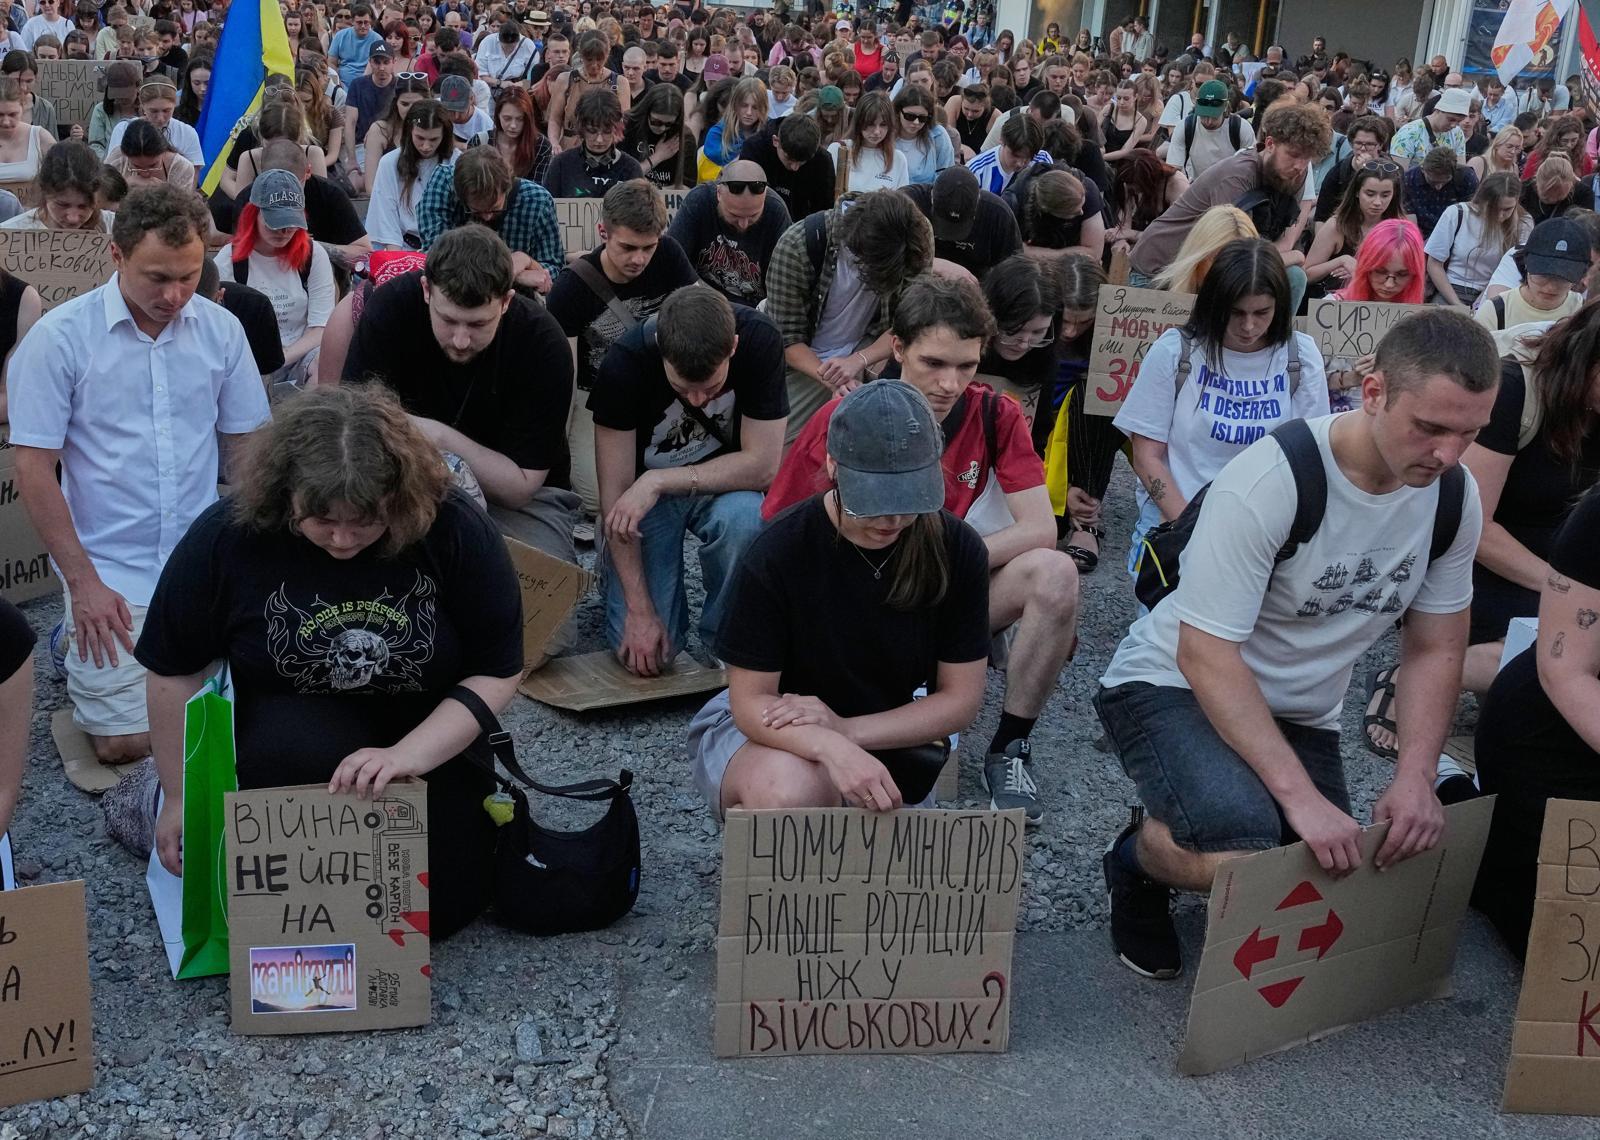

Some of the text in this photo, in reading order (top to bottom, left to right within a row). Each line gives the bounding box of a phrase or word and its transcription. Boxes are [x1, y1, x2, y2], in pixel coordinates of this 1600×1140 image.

[40, 81, 61, 98] НЕ
[1110, 317, 1183, 340] МОВЧ
[1315, 302, 1371, 332] СИР
[1213, 396, 1282, 420] DESERTED
[0, 552, 49, 588] ІДАТ
[315, 606, 340, 623] ONE
[342, 600, 354, 613] IS
[356, 600, 408, 628] PERFECT
[235, 798, 360, 845] ВІЙНА
[236, 845, 371, 892] НЕ ЙДЕ
[753, 811, 1019, 894] ЧОМУ У МІНІСТРІВ
[388, 842, 401, 923] ВЕЗЕ КАРТОН
[282, 903, 335, 934] НА
[746, 888, 847, 956] БІЛЬШЕ
[1561, 913, 1600, 982] З
[252, 949, 354, 1004] канікулі
[797, 956, 902, 1001] НІЖ У
[750, 971, 1006, 1051] ВІЙСЬКОВИХ?
